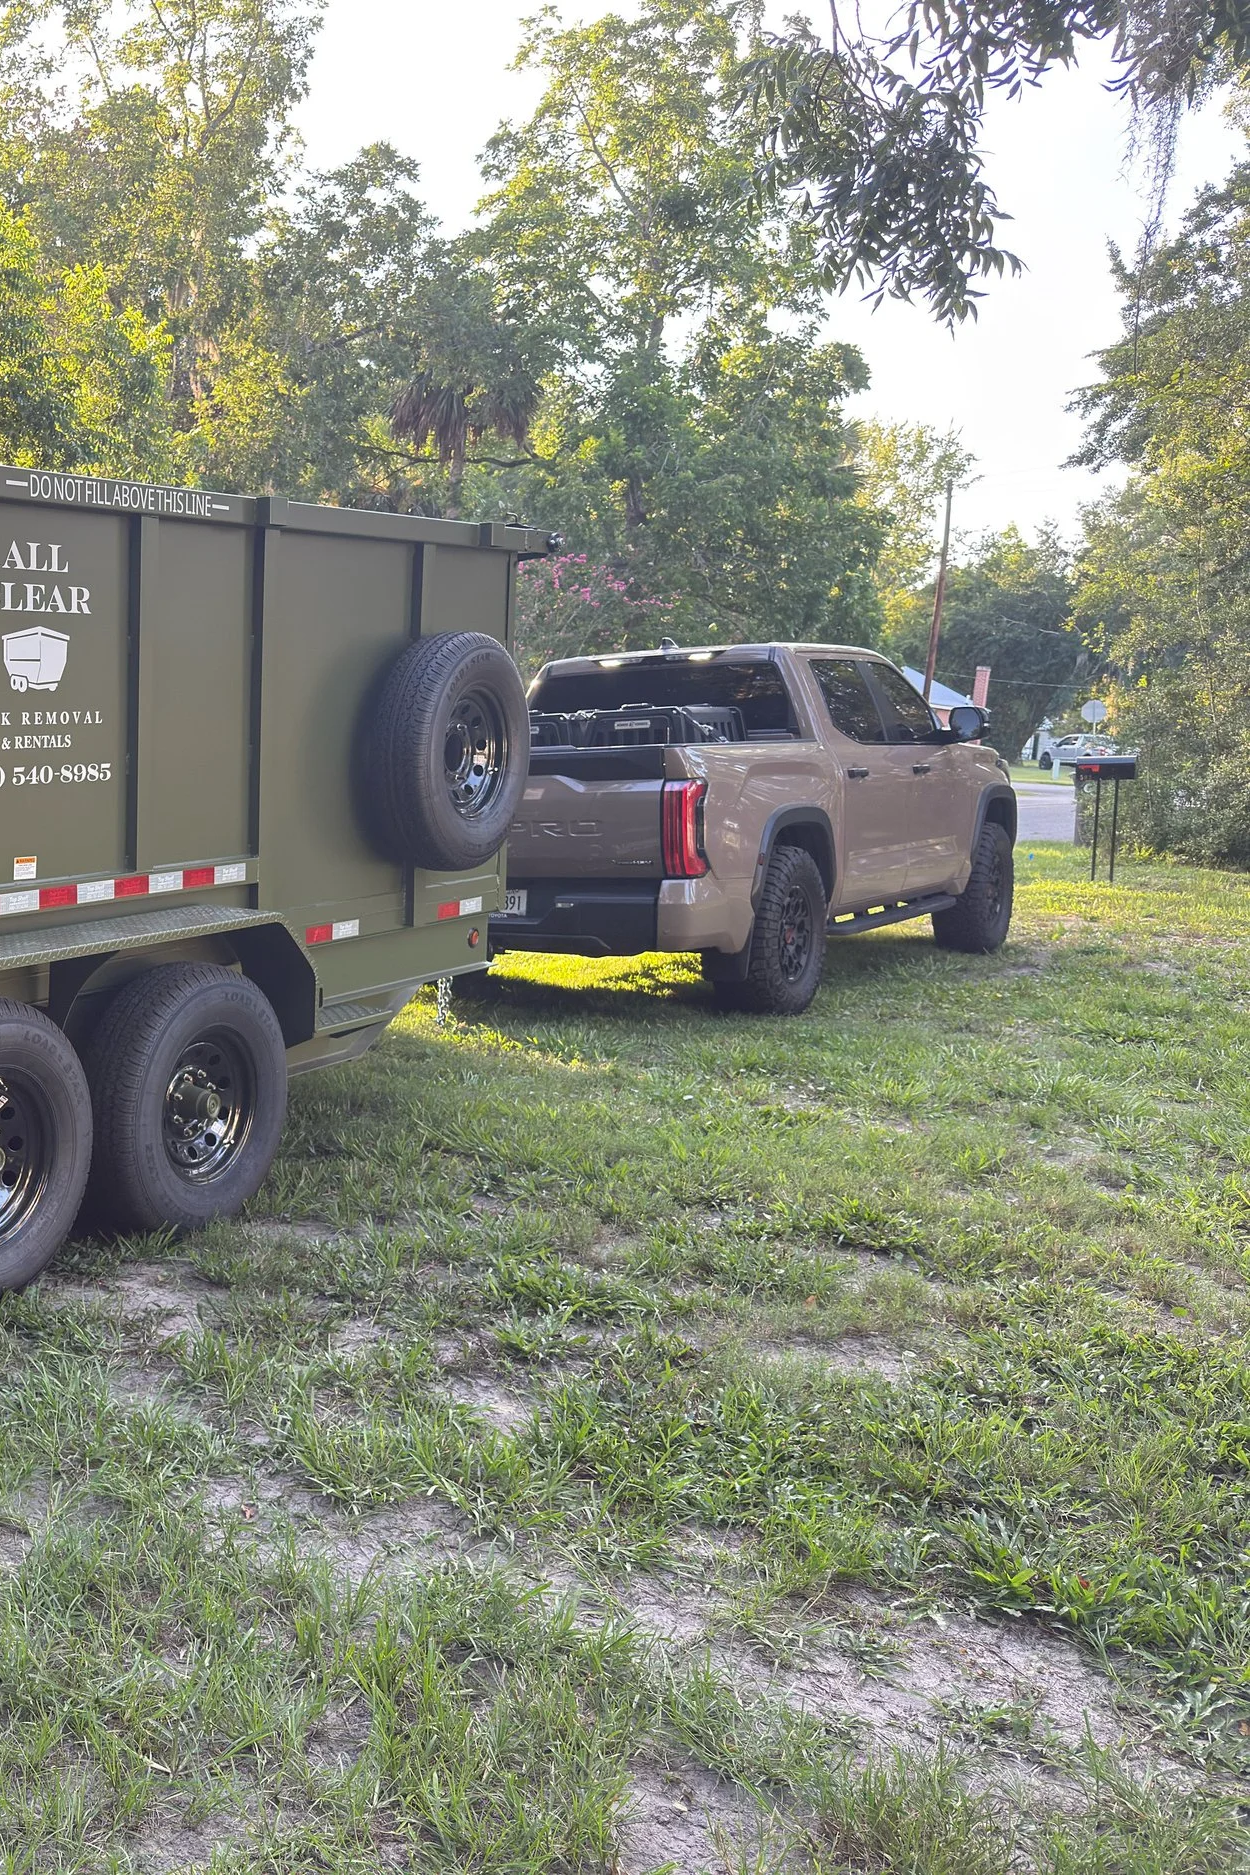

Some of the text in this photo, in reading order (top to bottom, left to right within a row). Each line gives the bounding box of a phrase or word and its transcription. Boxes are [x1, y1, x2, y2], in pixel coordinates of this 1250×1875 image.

[29, 474, 212, 517] DO NOT FILL ABOVE THIS LINE
[2, 540, 69, 573] ALL
[21, 710, 103, 726] REMOVAL
[1, 734, 72, 751] & RENTALS
[12, 763, 112, 787] 540-8985
